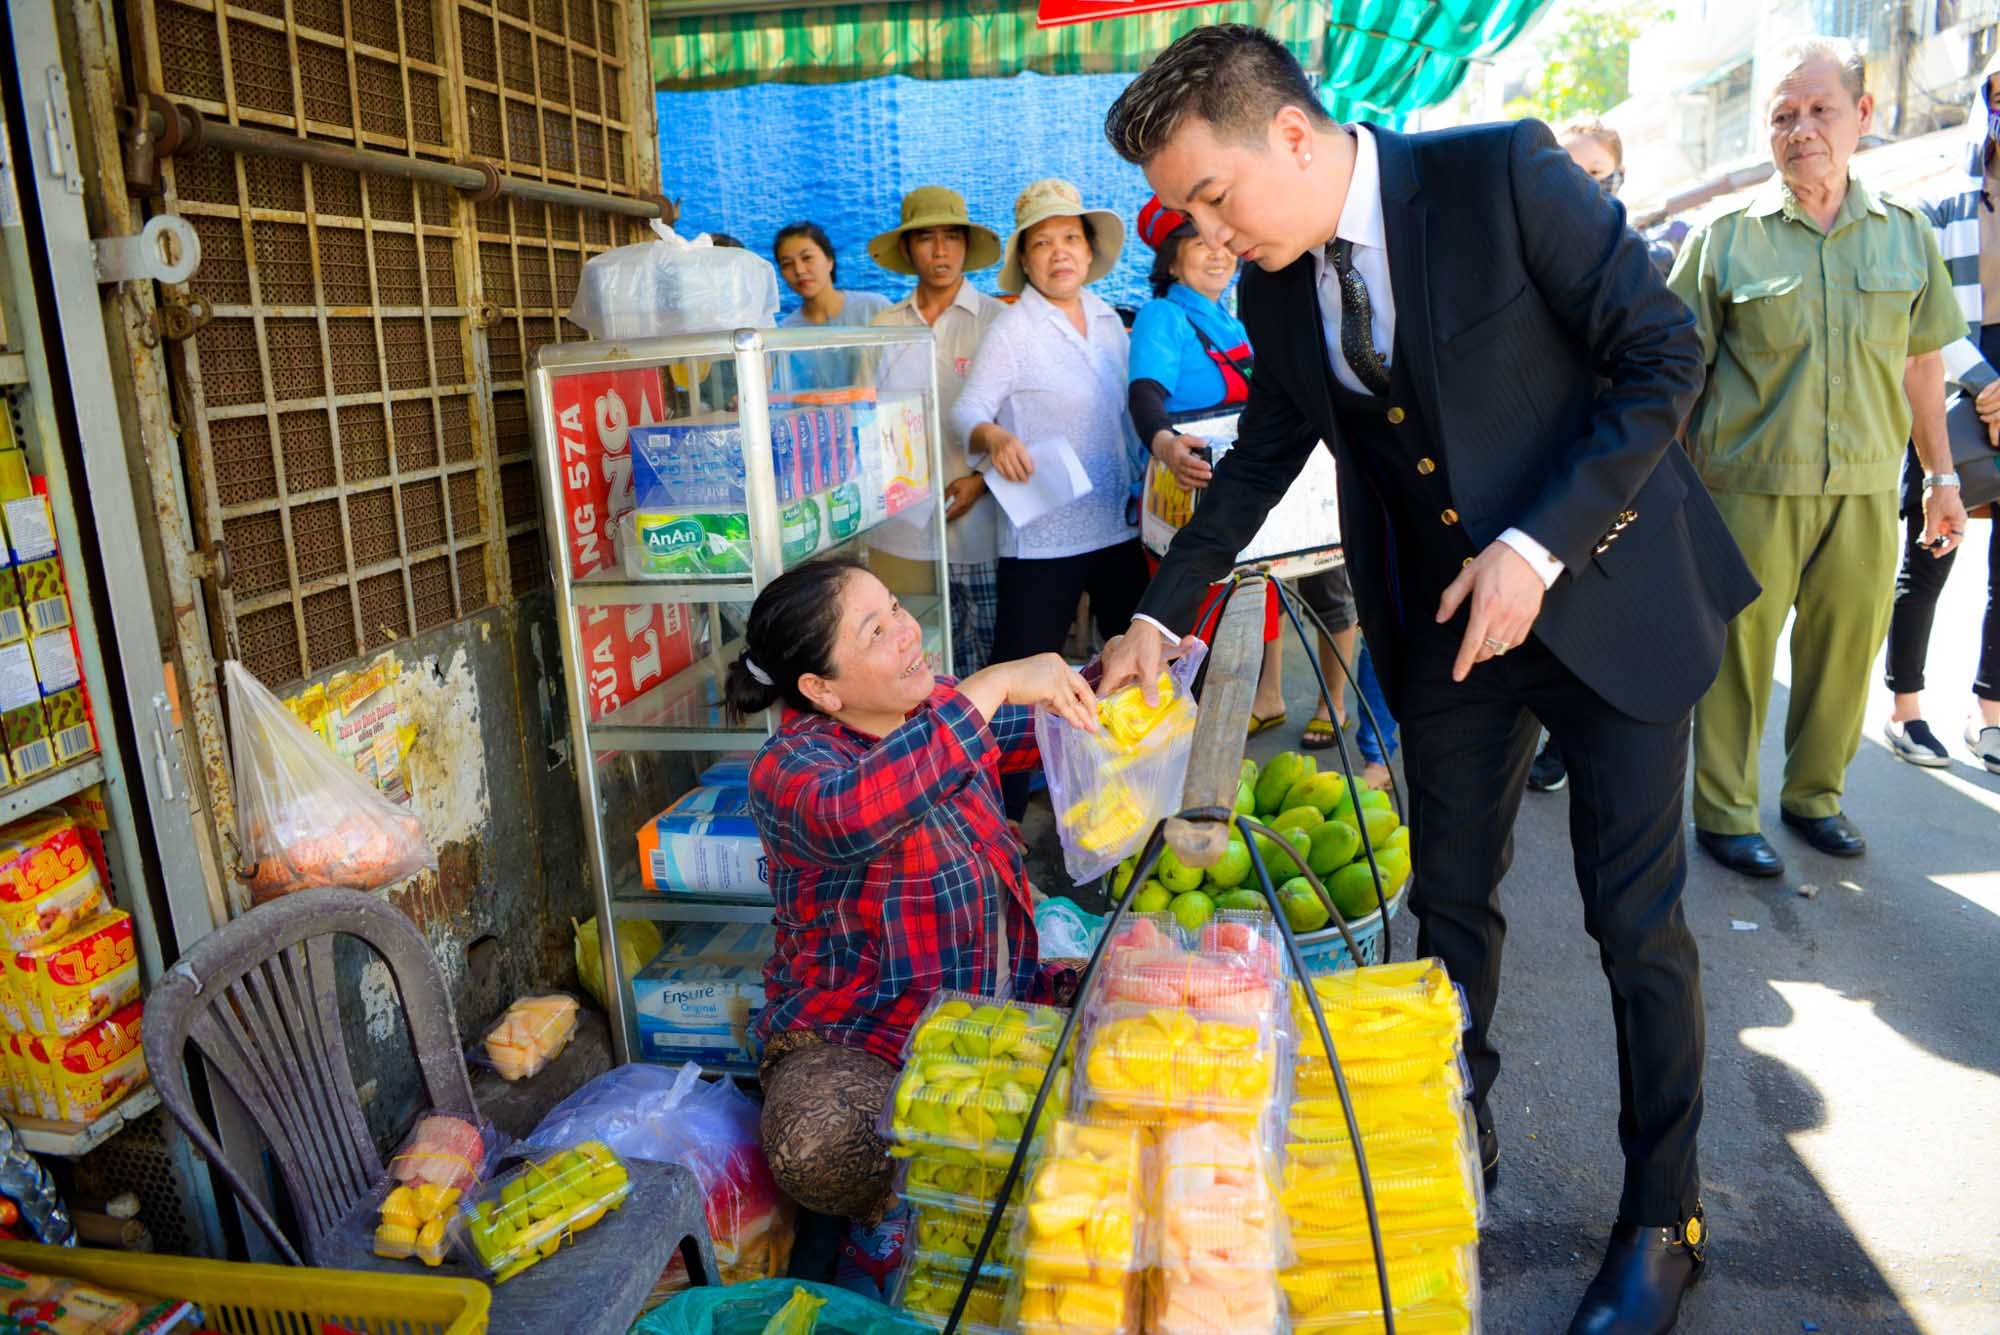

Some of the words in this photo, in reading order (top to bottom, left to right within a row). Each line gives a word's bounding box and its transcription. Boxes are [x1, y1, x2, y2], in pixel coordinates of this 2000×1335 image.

[560, 403, 590, 489] 57A
[648, 529, 697, 546] AnAn
[589, 635, 621, 718] CỬA
[662, 985, 714, 1004] Ensure
